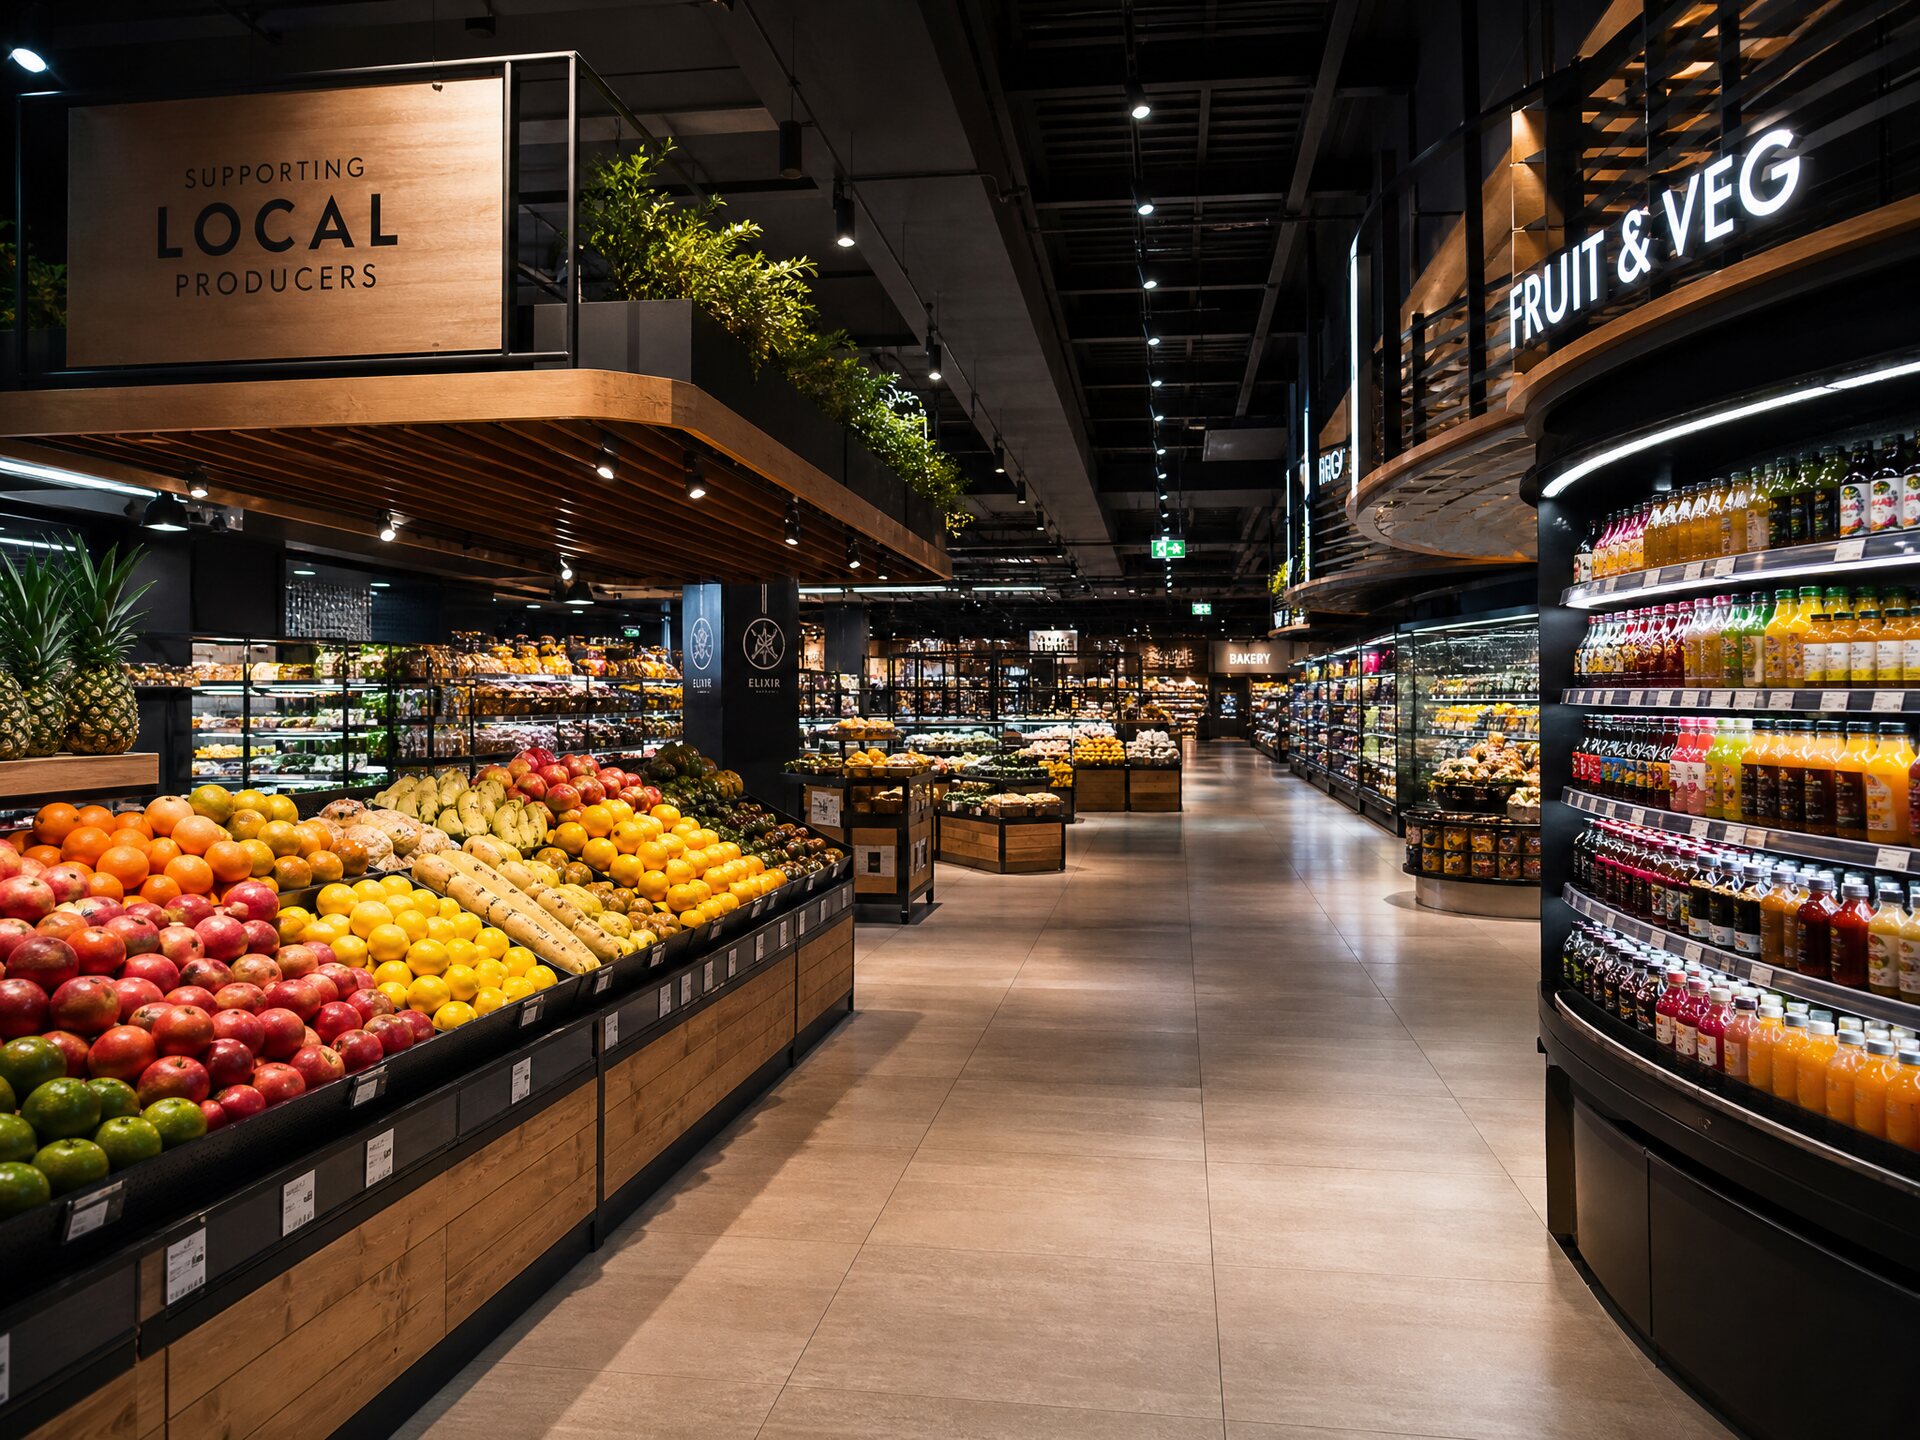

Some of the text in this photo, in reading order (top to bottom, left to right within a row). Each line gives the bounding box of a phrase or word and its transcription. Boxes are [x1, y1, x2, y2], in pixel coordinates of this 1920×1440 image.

[185, 157, 365, 189] SUPPORTING
[157, 193, 398, 259] LOCAL
[1509, 128, 1801, 350] FRUIT & VEG
[176, 263, 377, 297] PRODUCERS
[1229, 653, 1271, 665] BAKERY
[748, 678, 781, 688] ELIXIR
